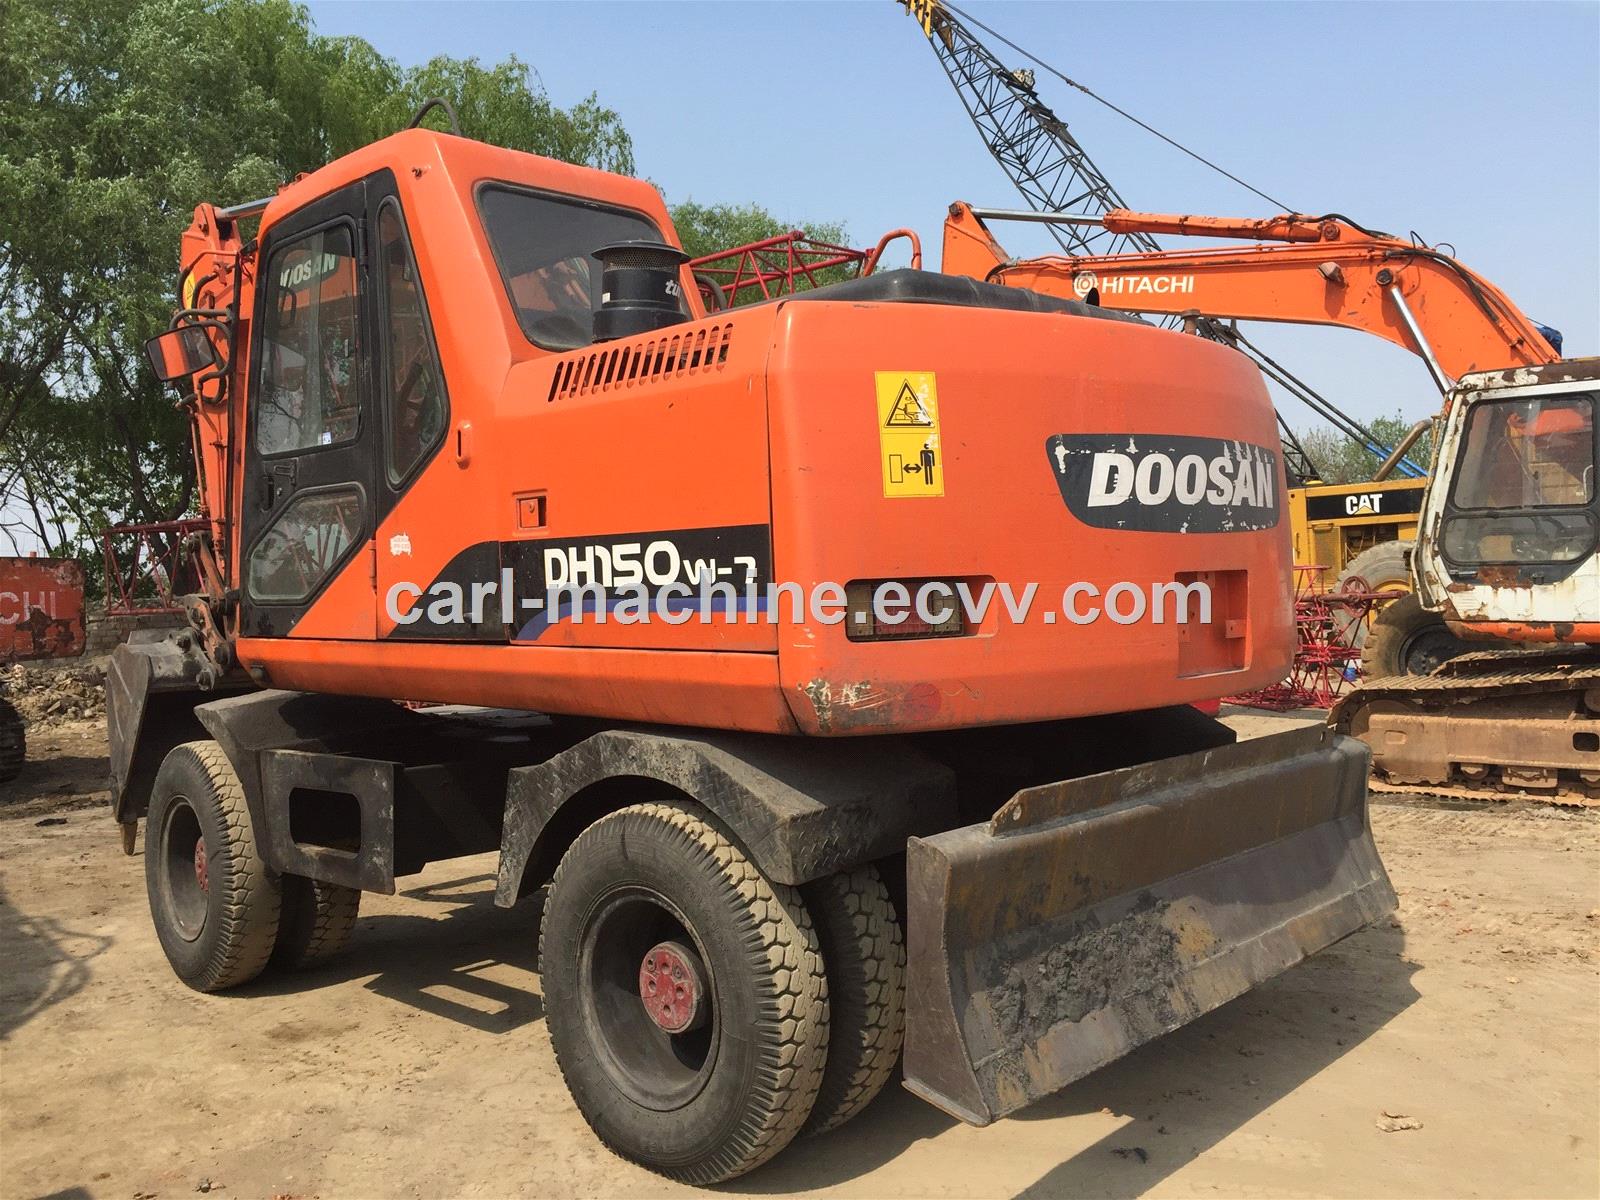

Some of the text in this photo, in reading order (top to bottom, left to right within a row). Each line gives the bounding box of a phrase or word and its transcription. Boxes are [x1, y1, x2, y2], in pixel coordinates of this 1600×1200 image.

[1101, 275, 1195, 294] HITACHI
[1087, 452, 1274, 508] DOOSAN
[1345, 493, 1383, 515] CAT
